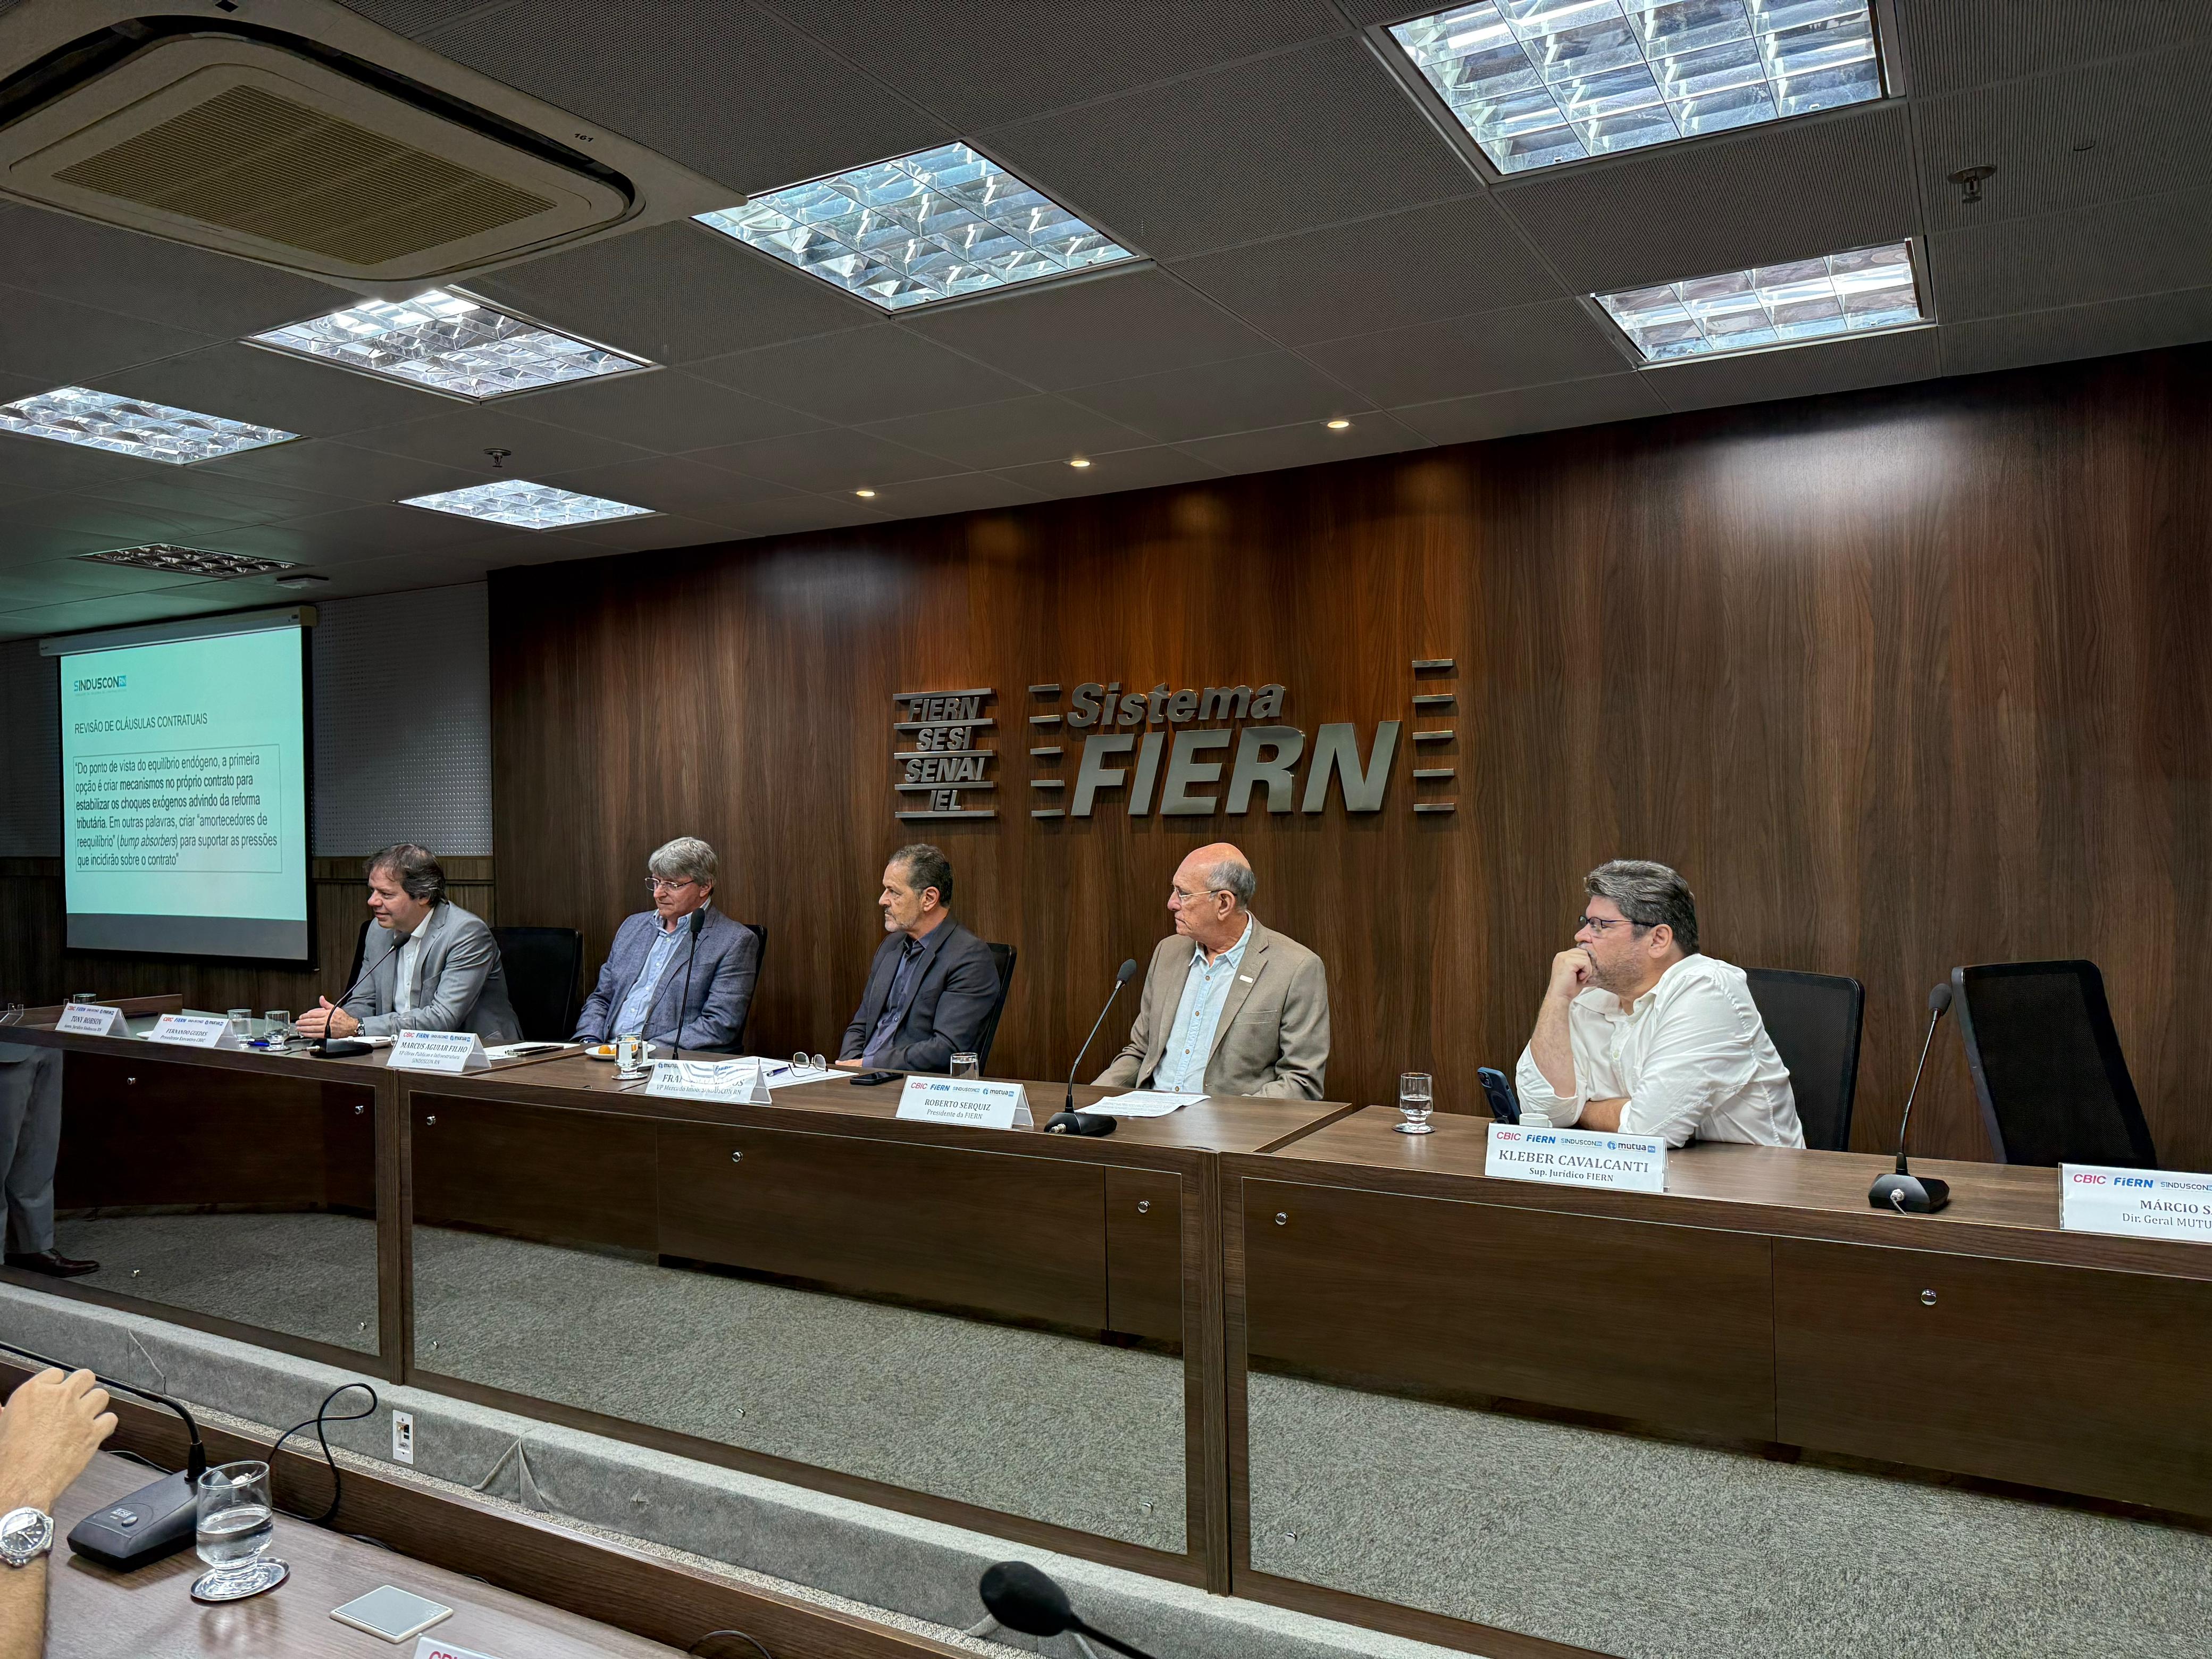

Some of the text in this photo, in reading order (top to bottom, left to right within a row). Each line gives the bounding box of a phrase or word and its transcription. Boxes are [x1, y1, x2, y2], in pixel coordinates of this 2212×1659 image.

[574, 133, 594, 143] 161
[907, 697, 980, 722] FIERN
[1067, 681, 1286, 727] Sistema
[75, 713, 207, 734] REVISÃO DE CLÁUSULAS CONTRATUAIS
[916, 727, 972, 751] SESI
[89, 763, 107, 776] ponto
[109, 760, 118, 772] de
[120, 759, 135, 771] vista
[137, 759, 146, 770] do
[148, 757, 179, 773] equilíbrio
[181, 755, 220, 771] endógeno,
[222, 757, 227, 766] a
[229, 752, 259, 769] primeira
[904, 757, 985, 783] SENAI
[1070, 720, 1402, 816] FIERN
[76, 774, 253, 795] opção é criar mecanismos no próprio contrato para
[76, 792, 260, 812] estabilizar os choques exógenos advindo da reforma
[928, 790, 962, 811] IEL
[77, 812, 267, 831] tributária. Em outras palavras, criar "amortecedores de
[118, 834, 139, 850] (bump
[141, 832, 178, 849] absorbers)
[180, 836, 196, 849] para
[198, 834, 229, 849] suportar
[231, 836, 239, 846] as
[241, 833, 277, 849] pressões
[78, 856, 89, 868] que
[91, 853, 119, 866] incidirão
[121, 853, 139, 866] sobre
[141, 856, 146, 865] o
[925, 1099, 991, 1111] ROBERTO SERQUIZ
[927, 1109, 956, 1117] Presidente
[1496, 1131, 1521, 1141] CBIC
[1561, 1138, 1596, 1146] SINDUSCON
[1499, 1150, 1649, 1173] KLEBER CAVALCANTI
[1529, 1167, 1613, 1182] Sup. Jurídico FIERN
[2073, 1174, 2107, 1185] CBIC
[2160, 1182, 2208, 1191] SINDUSCON
[2140, 1199, 2198, 1214] MÁRCIO
[2123, 1213, 2141, 1223] Dir.
[2144, 1215, 2173, 1226] Geral
